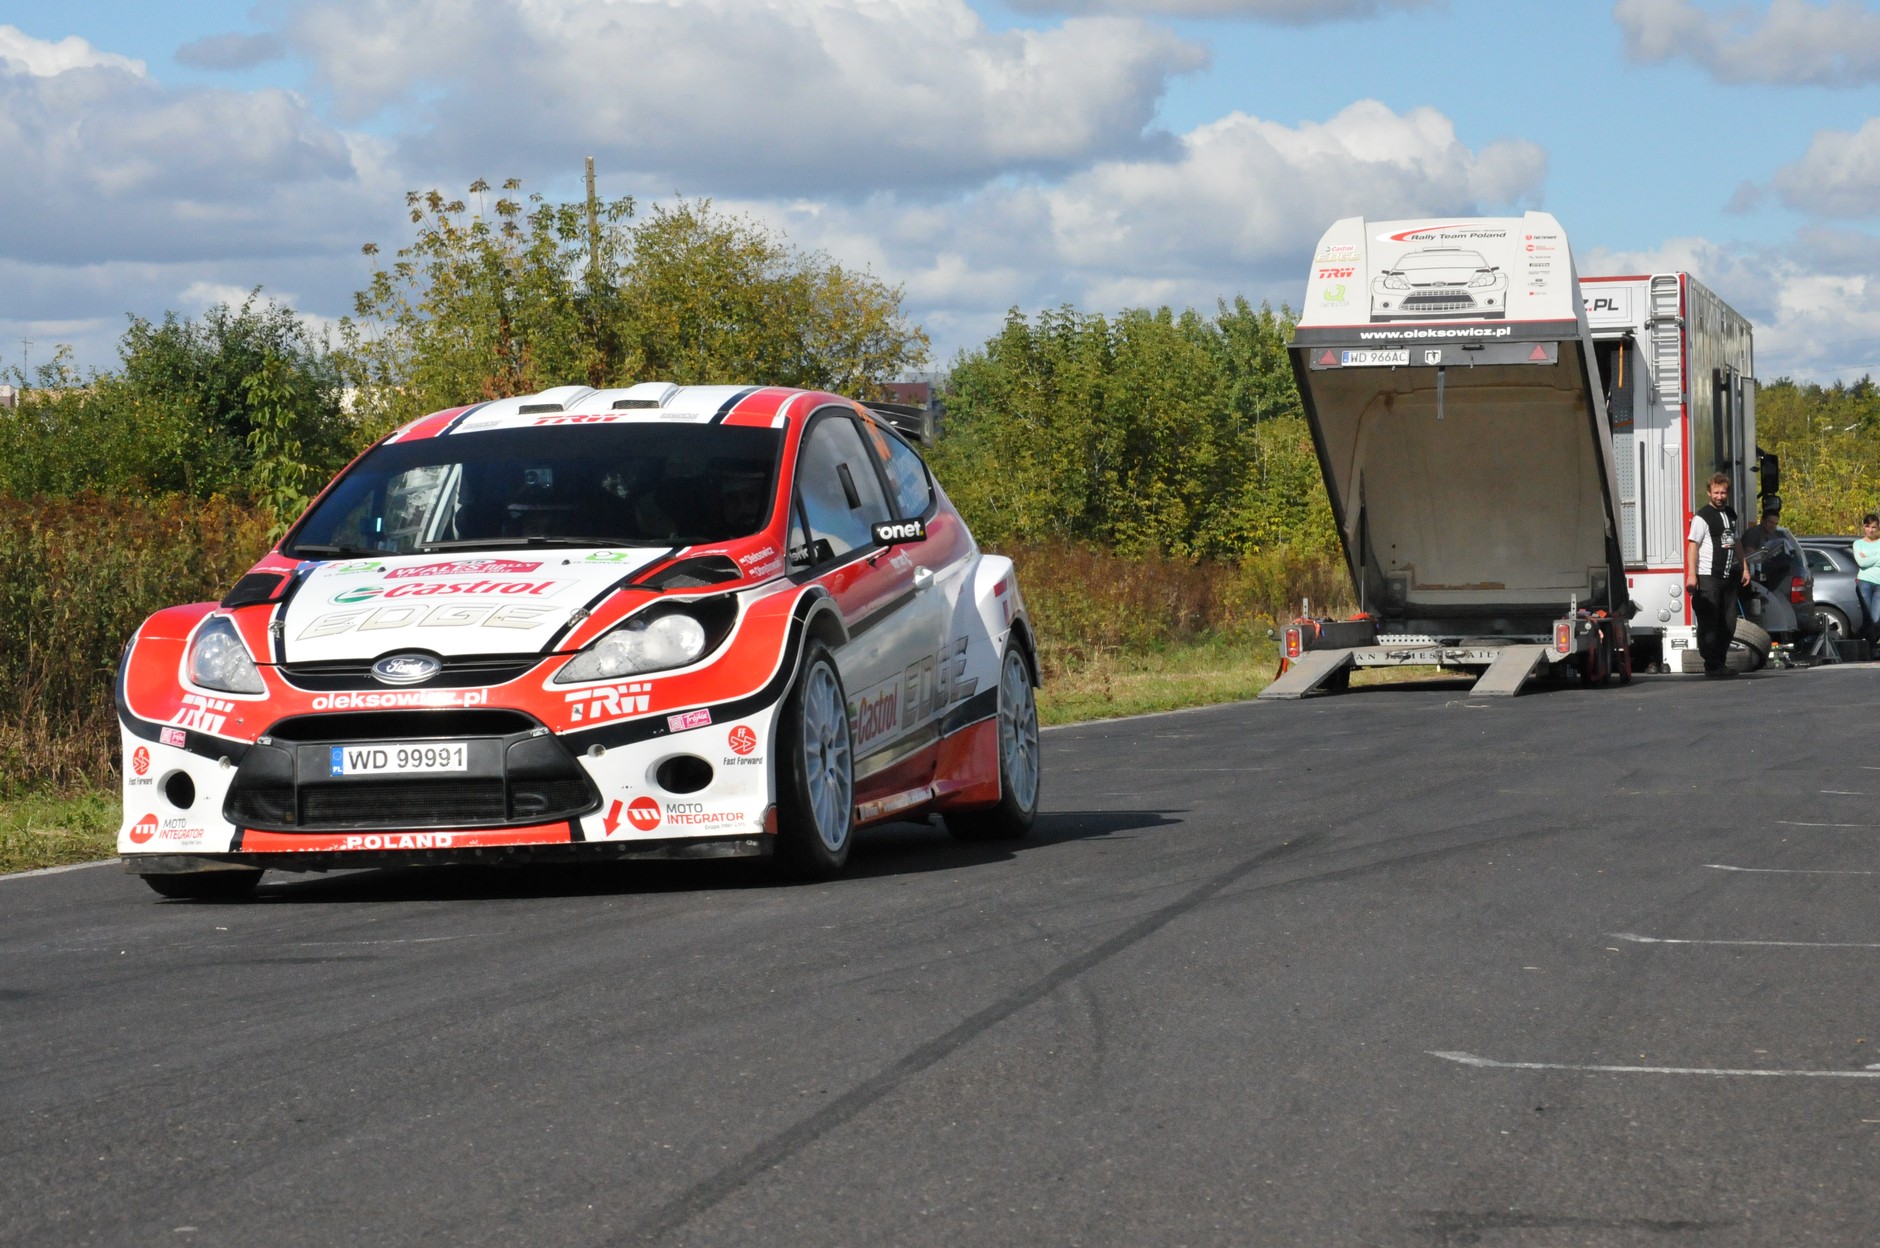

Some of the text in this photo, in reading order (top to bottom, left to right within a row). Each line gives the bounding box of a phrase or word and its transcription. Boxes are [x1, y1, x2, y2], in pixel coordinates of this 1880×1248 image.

[1319, 267, 1355, 279] TRW
[1360, 327, 1511, 339] www.oleksowicz.pl
[1351, 351, 1407, 362] WD 966AC
[533, 413, 629, 425] TRW
[384, 580, 556, 598] Castrol
[296, 603, 566, 641] EDGE
[386, 659, 424, 673] Ford
[902, 636, 978, 731] EDGE
[565, 682, 652, 722] TRW
[170, 694, 235, 734] TRW
[857, 682, 898, 746] Castrol
[348, 747, 463, 770] WD 99991
[723, 756, 763, 766] Fast Forward
[137, 777, 153, 785] Forward
[666, 803, 703, 814] MOTO
[163, 818, 187, 829] MOTO
[667, 812, 744, 825] INTEGRATOR
[159, 829, 204, 840] INTEGRATOR
[346, 834, 453, 849] POLAND
